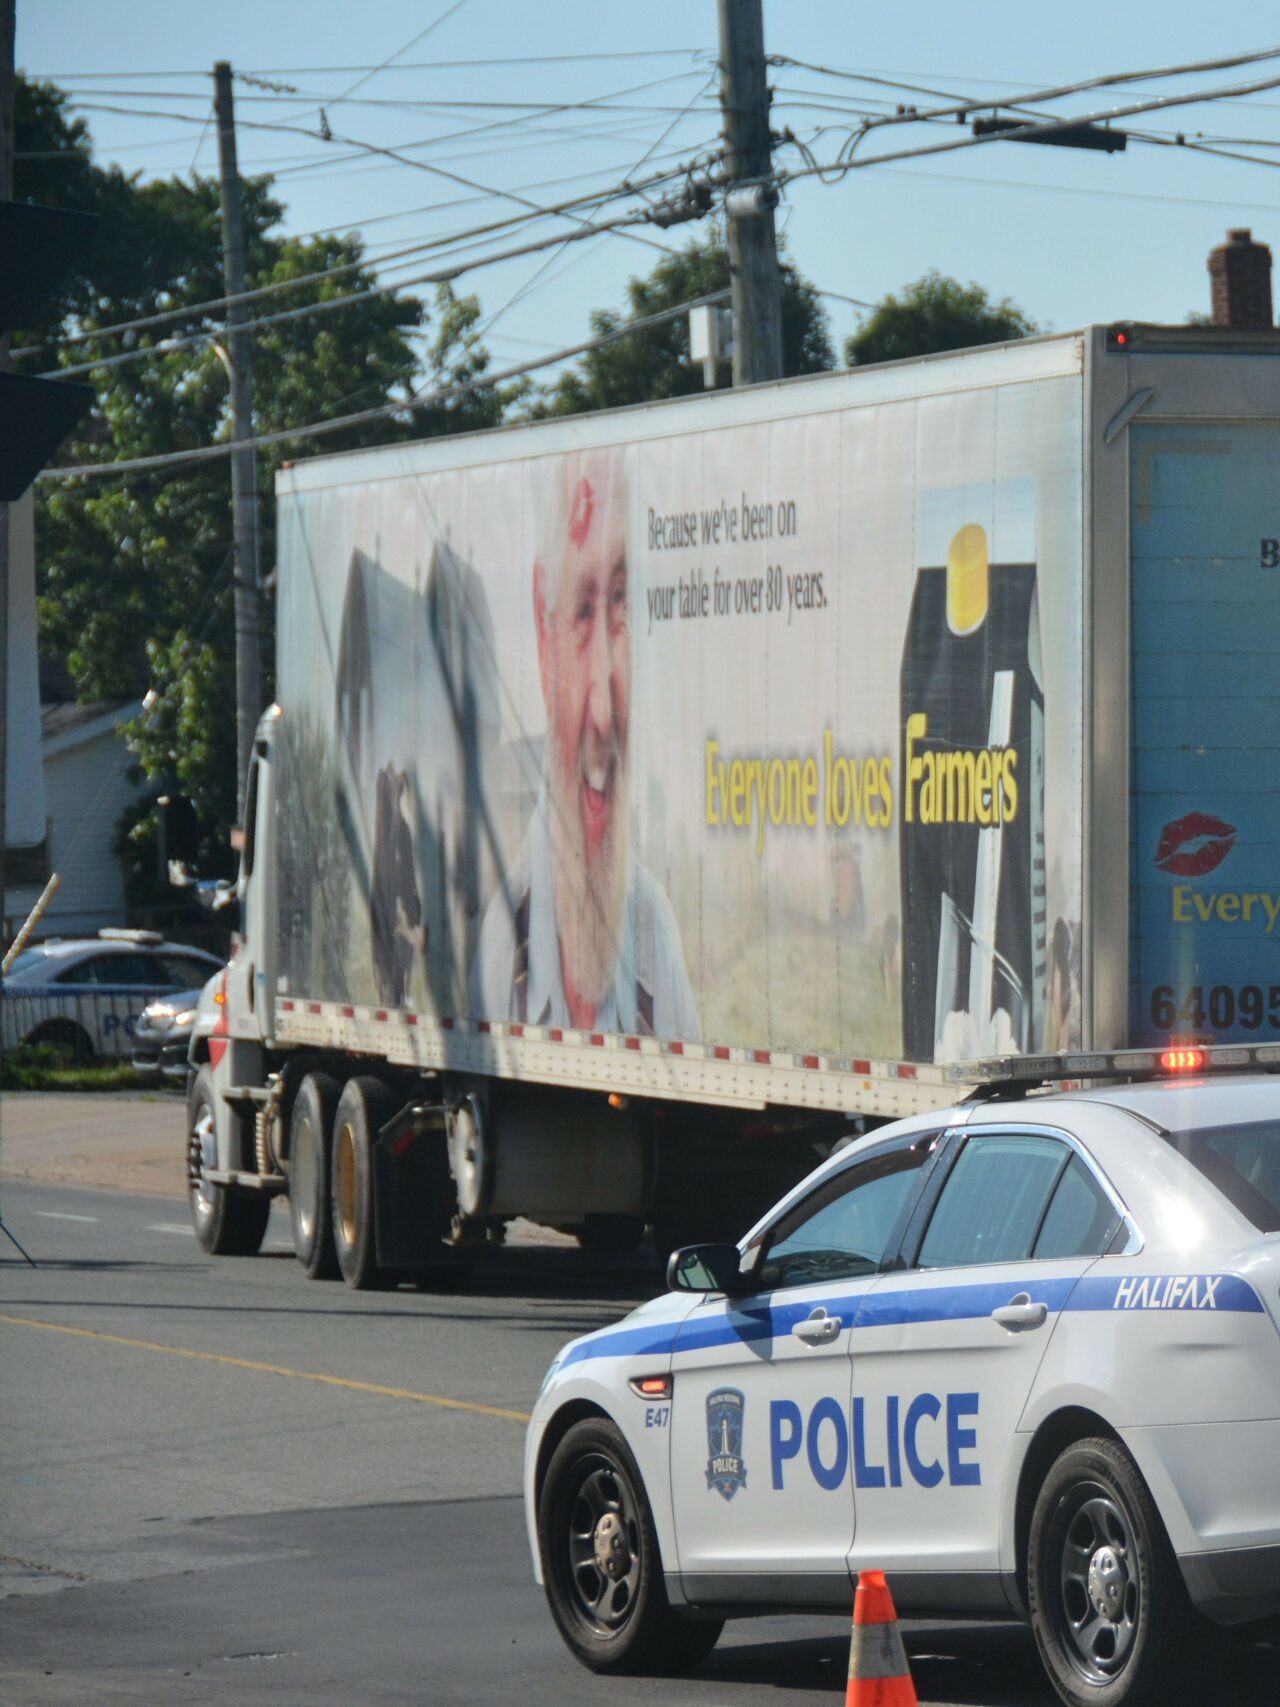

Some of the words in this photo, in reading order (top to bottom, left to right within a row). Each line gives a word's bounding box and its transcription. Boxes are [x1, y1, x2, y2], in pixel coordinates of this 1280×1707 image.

[647, 505, 698, 551] Because
[700, 499, 738, 544] we've
[741, 492, 773, 542] been
[777, 499, 797, 537] on
[647, 582, 676, 635] your
[678, 570, 709, 620] table
[713, 566, 731, 616] for
[734, 575, 763, 614] over
[765, 565, 782, 612] 80
[786, 569, 828, 625] years.
[705, 739, 818, 852] Everyone
[824, 728, 893, 828] loves
[905, 713, 1018, 824] Farmers
[1112, 1275, 1223, 1310] HALIFAX
[645, 1407, 669, 1429] E47
[769, 1391, 981, 1491] POLICE
[712, 1457, 738, 1475] POLICE
